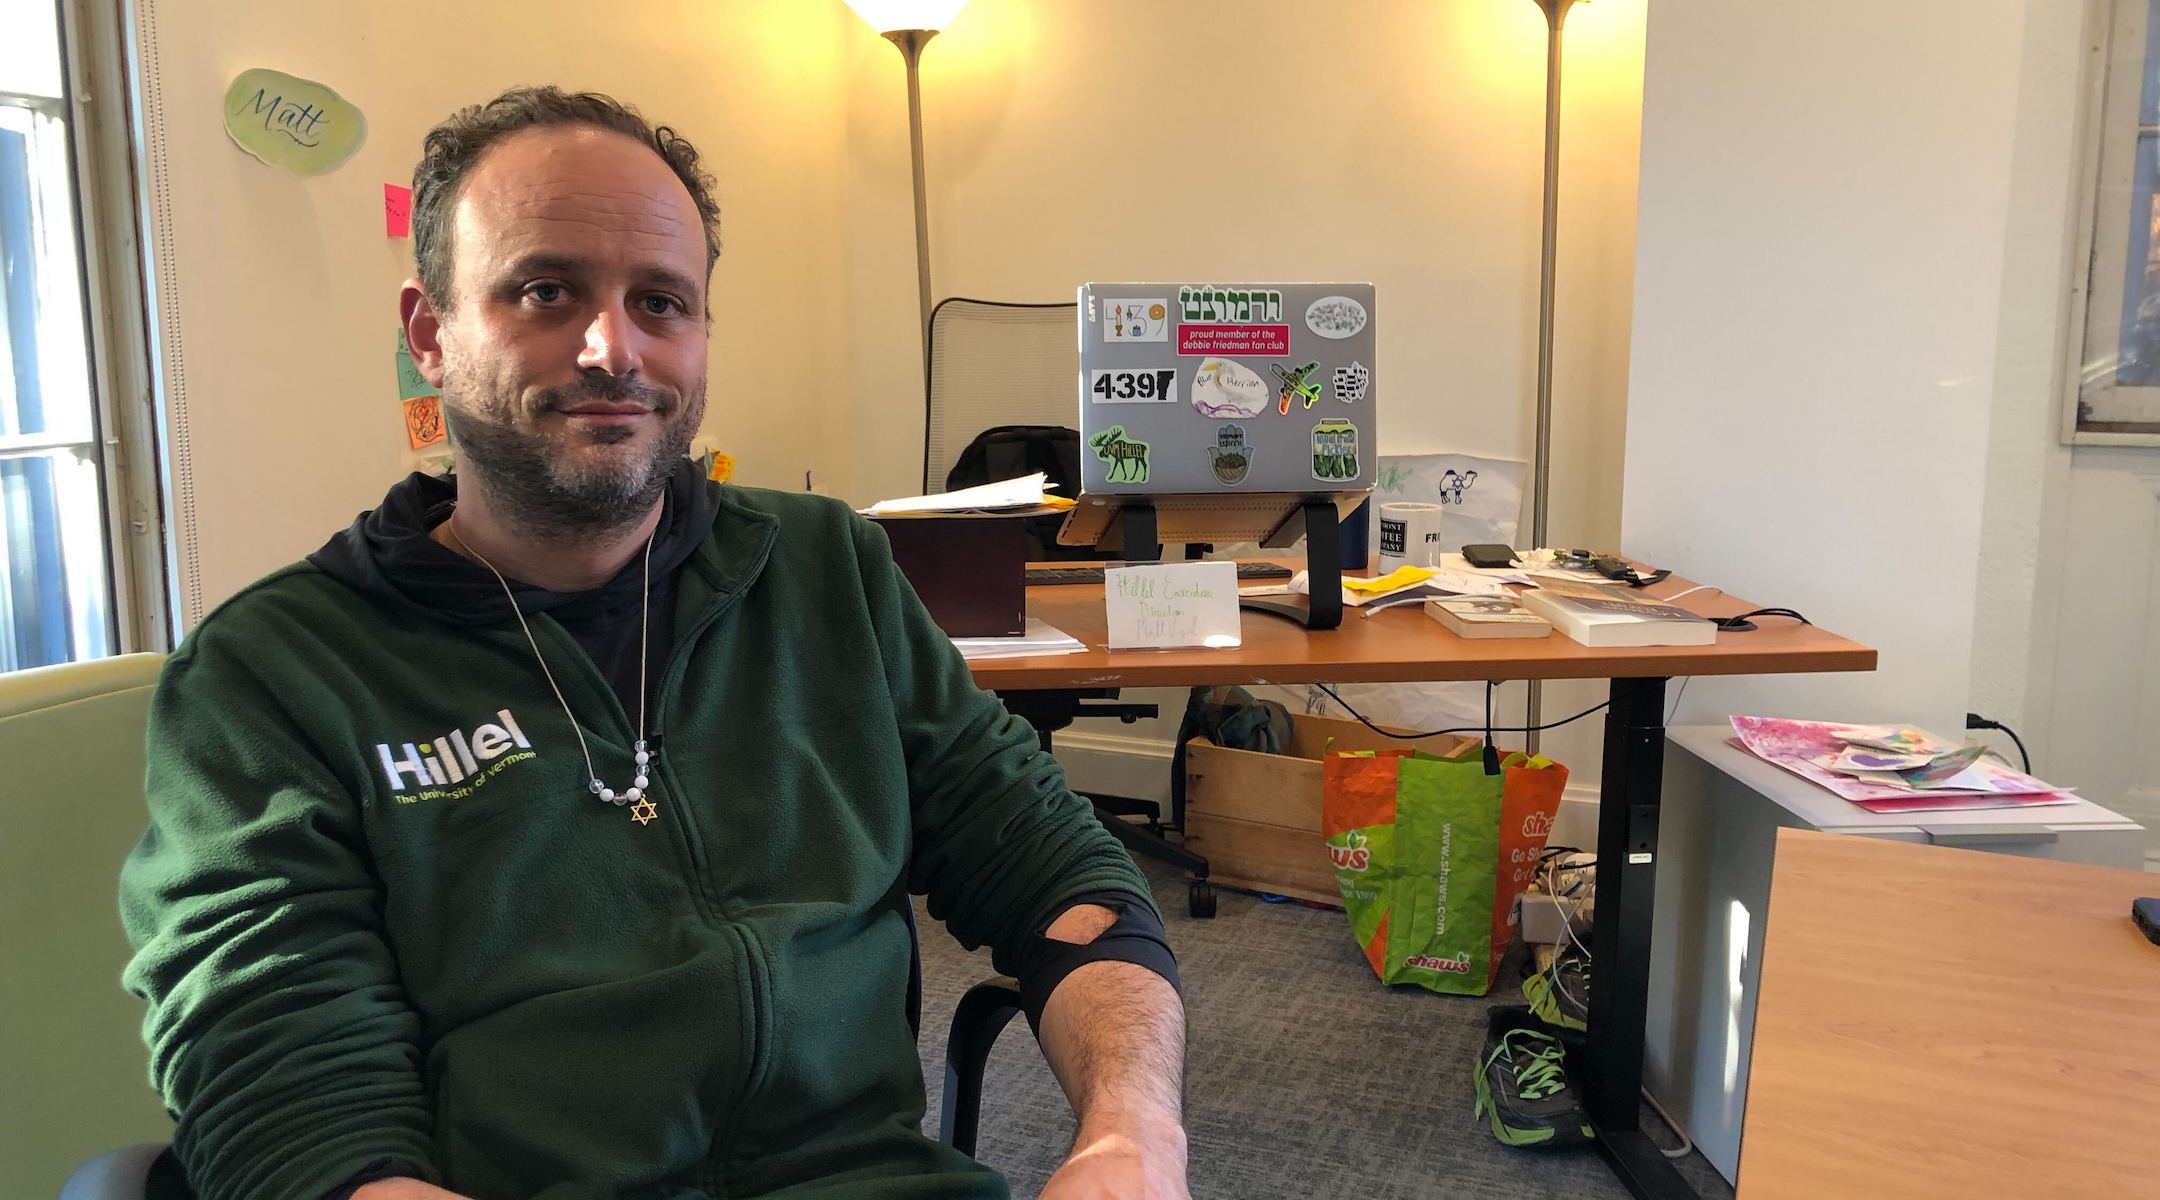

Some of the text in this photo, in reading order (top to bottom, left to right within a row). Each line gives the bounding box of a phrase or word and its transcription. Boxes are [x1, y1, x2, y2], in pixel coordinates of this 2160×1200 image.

[235, 88, 330, 139] Matt
[1183, 340, 1285, 350] debbie friedman fan club
[1190, 330, 1276, 340] proud member of the
[1094, 373, 1156, 399] 439
[376, 708, 532, 790] Hillel
[394, 794, 417, 806] The
[474, 772, 487, 787] of
[1511, 847, 1525, 864] Go
[1435, 823, 1451, 936] www.shaws.com
